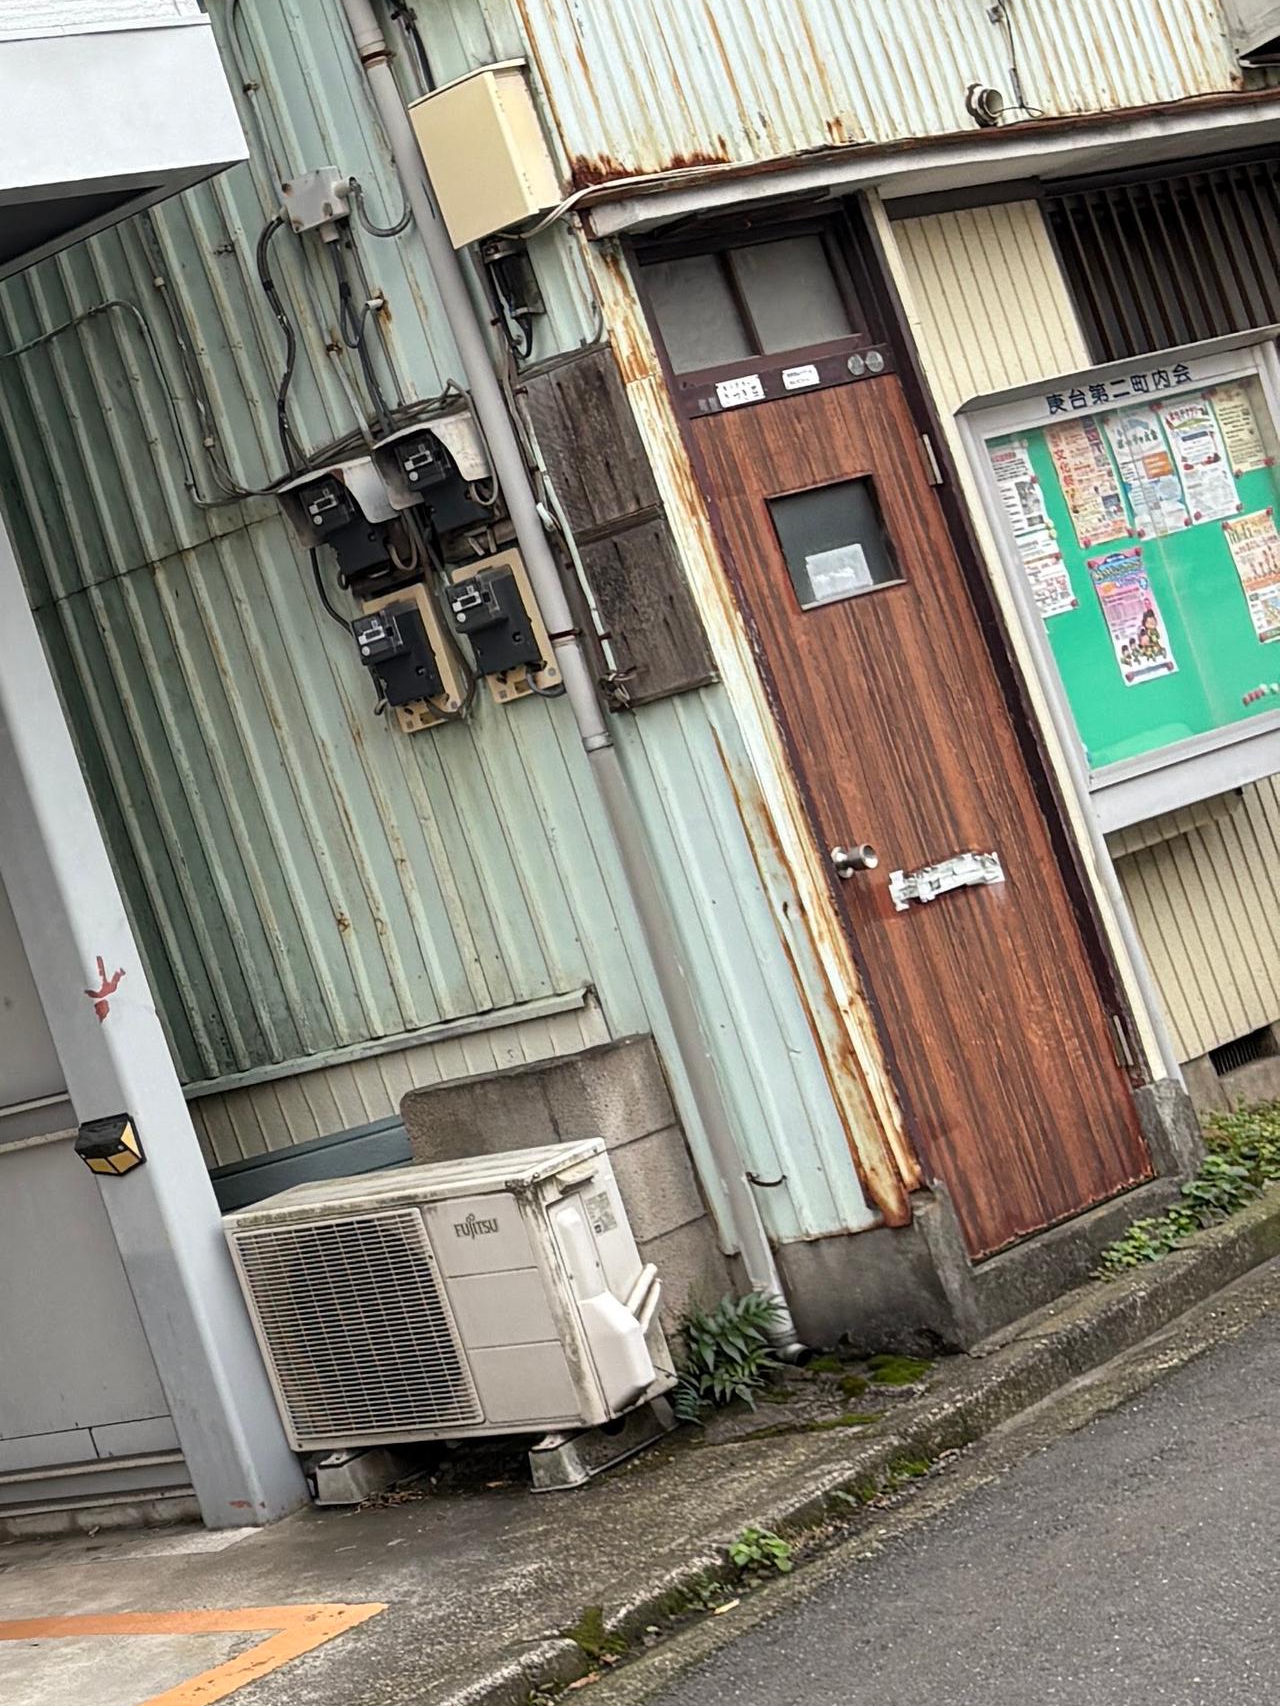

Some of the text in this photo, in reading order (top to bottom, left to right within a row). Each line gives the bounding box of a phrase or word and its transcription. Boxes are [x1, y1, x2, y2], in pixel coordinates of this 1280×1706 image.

[1045, 363, 1193, 415] 庚台第二町内会
[453, 1212, 499, 1240] FUJITSU
